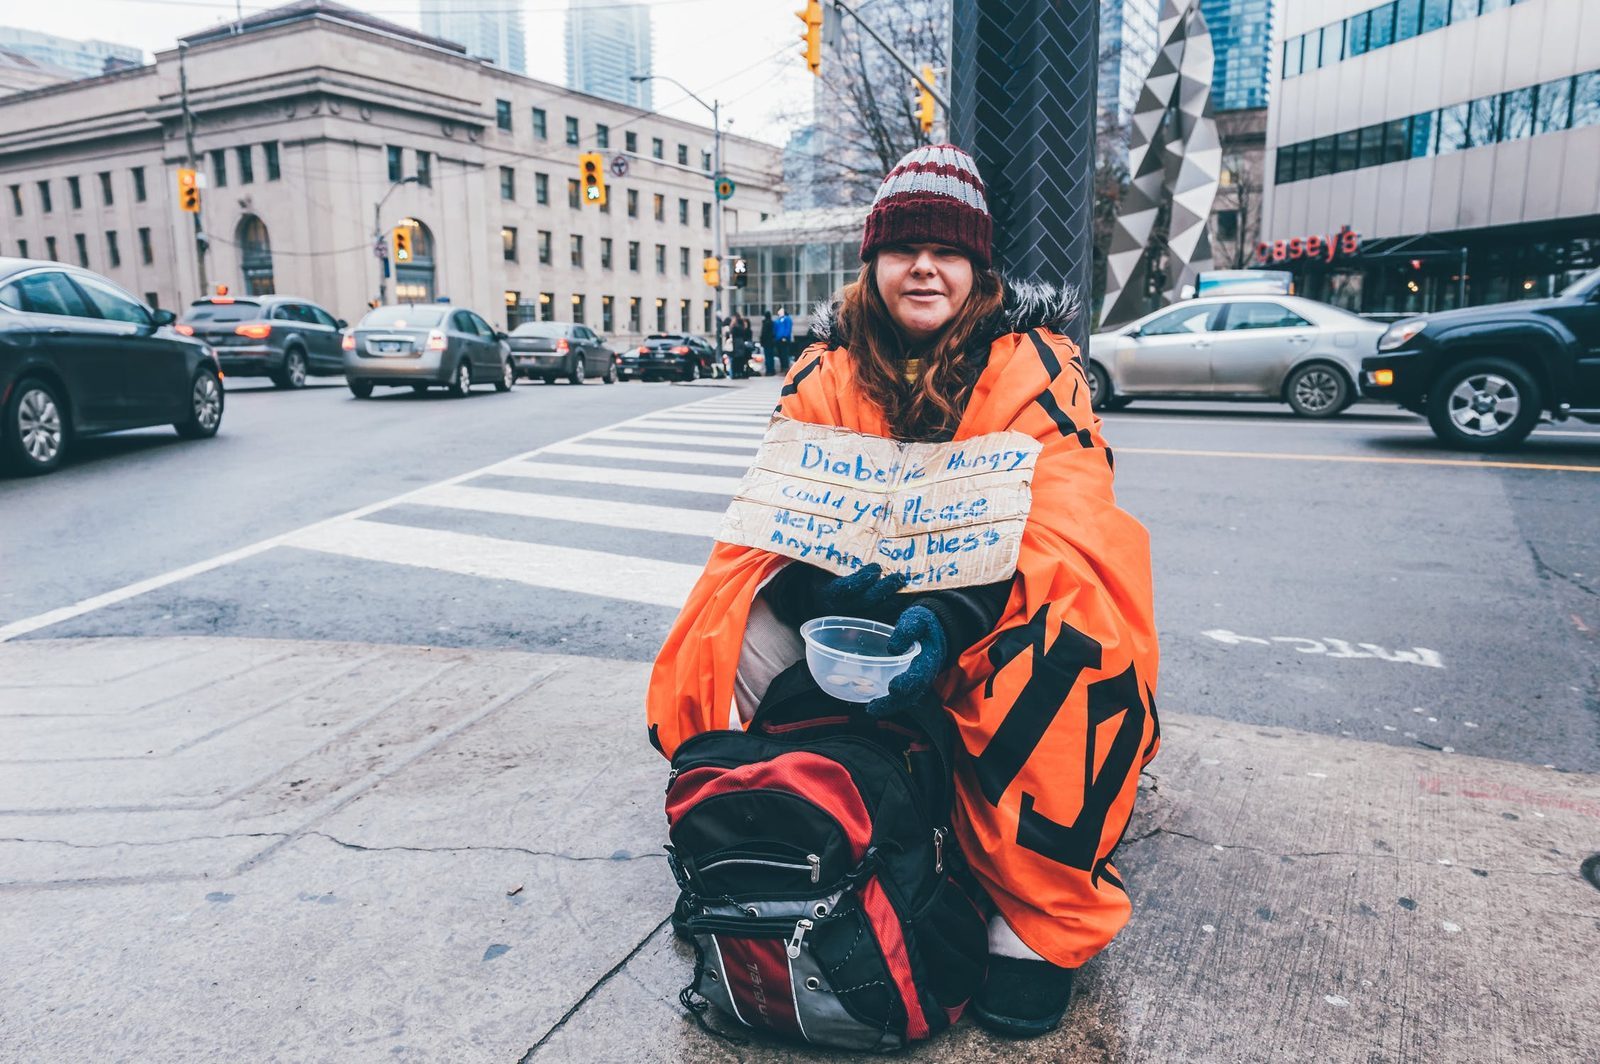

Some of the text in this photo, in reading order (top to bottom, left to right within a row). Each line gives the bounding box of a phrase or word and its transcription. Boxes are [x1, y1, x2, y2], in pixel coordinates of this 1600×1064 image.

[1256, 224, 1358, 263] casey's
[800, 443, 1029, 483] Diabetic Hungry
[902, 495, 989, 525] Please
